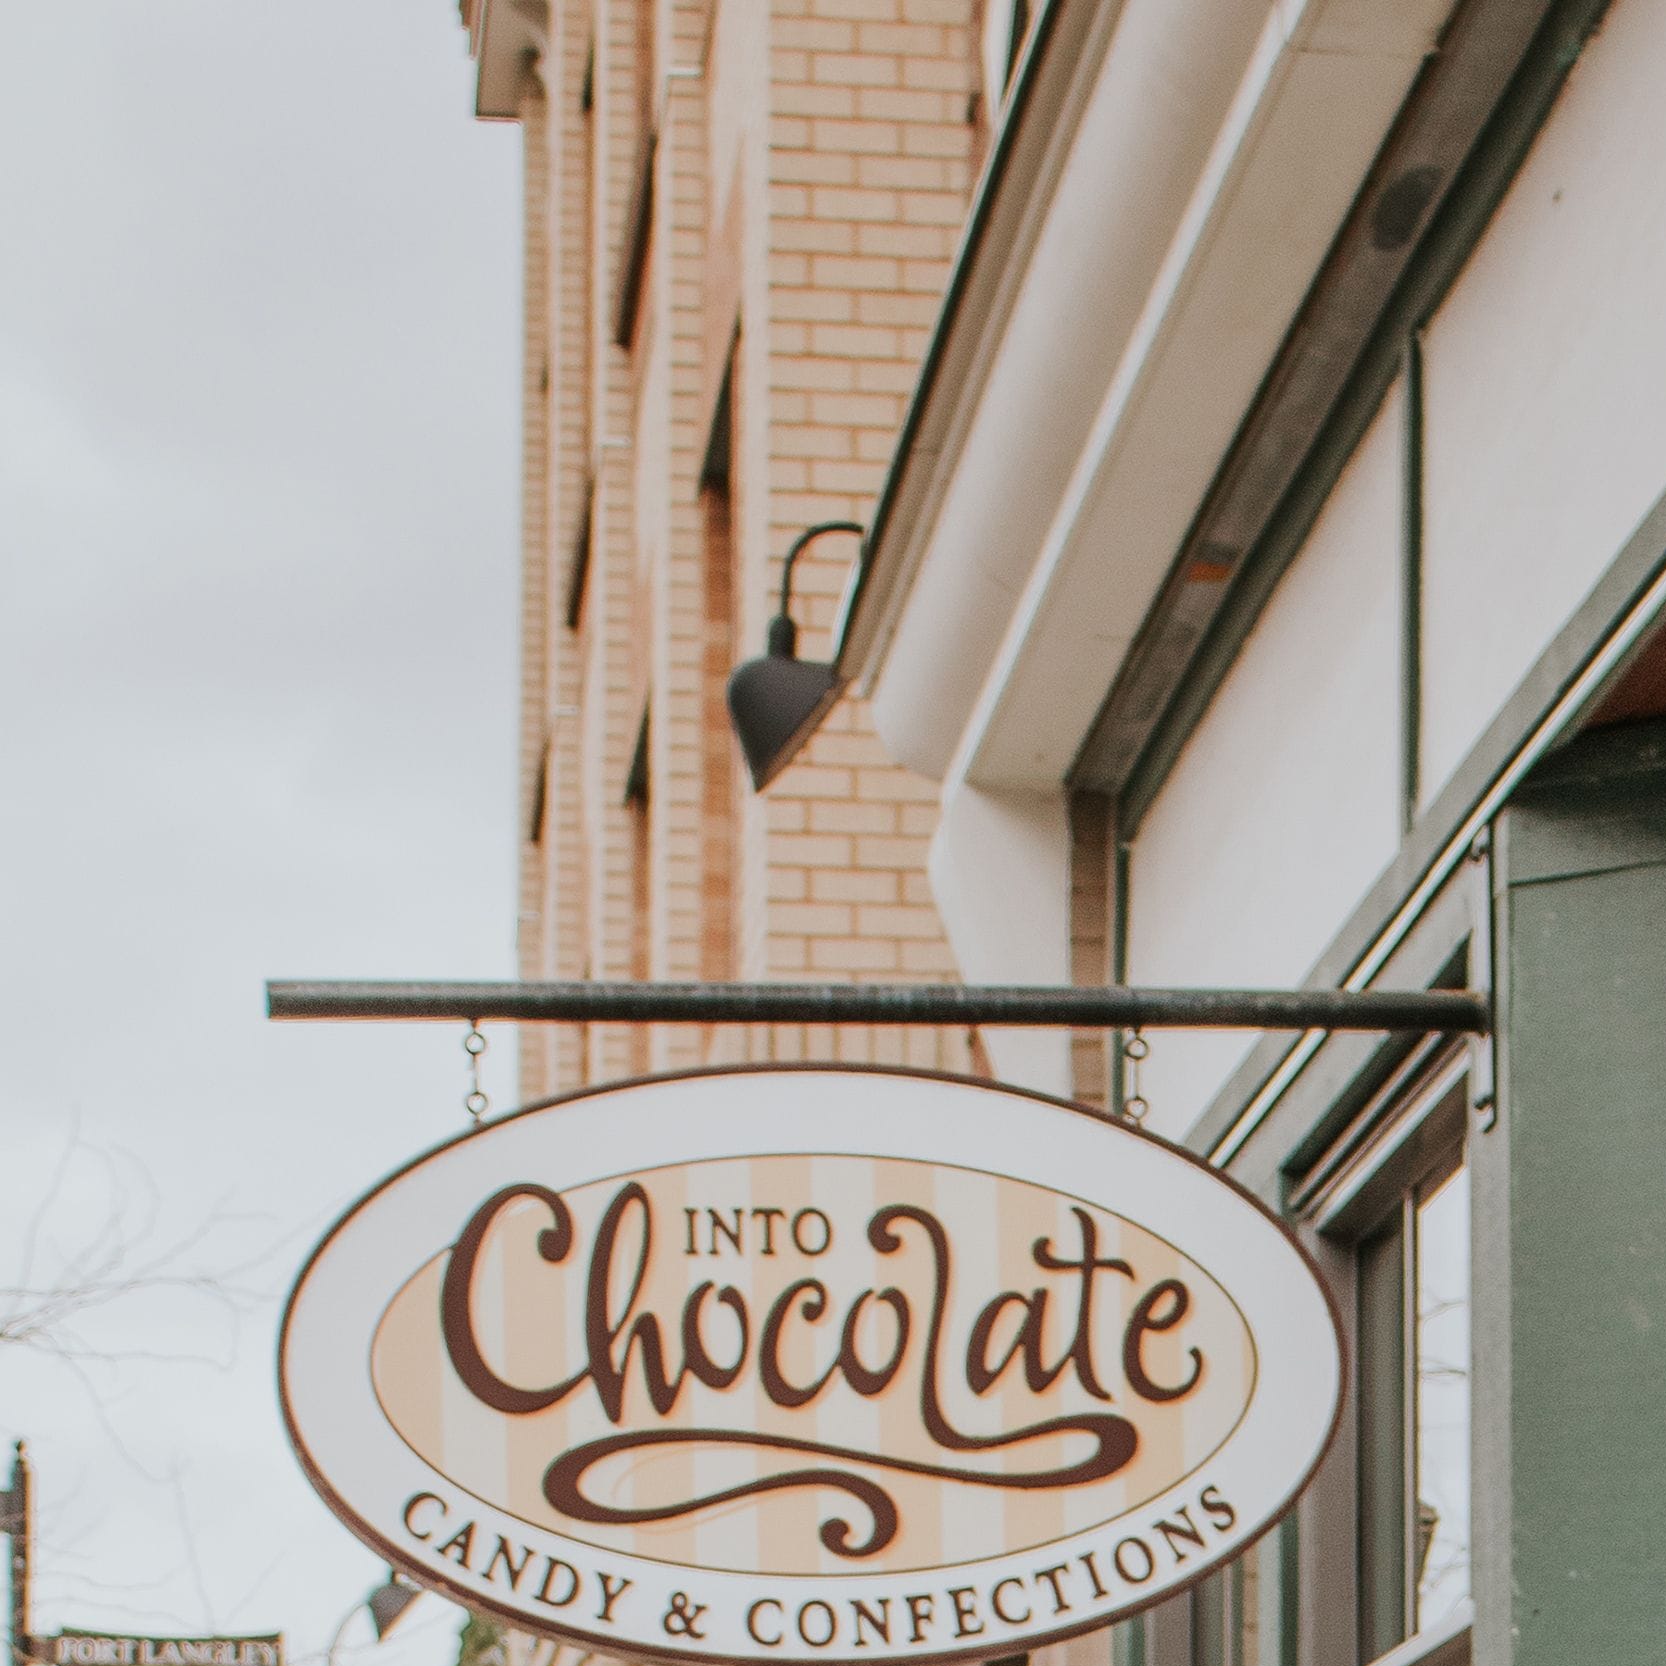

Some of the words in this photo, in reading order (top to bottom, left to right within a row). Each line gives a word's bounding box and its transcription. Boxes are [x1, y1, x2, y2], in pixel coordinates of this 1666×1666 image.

[683, 1206, 833, 1258] INTO
[440, 1180, 1205, 1558] Chocolate
[400, 1489, 633, 1624] CANDY
[662, 1591, 708, 1639] &
[745, 1484, 1240, 1648] CONFECTIONS
[59, 1637, 136, 1664] FORT
